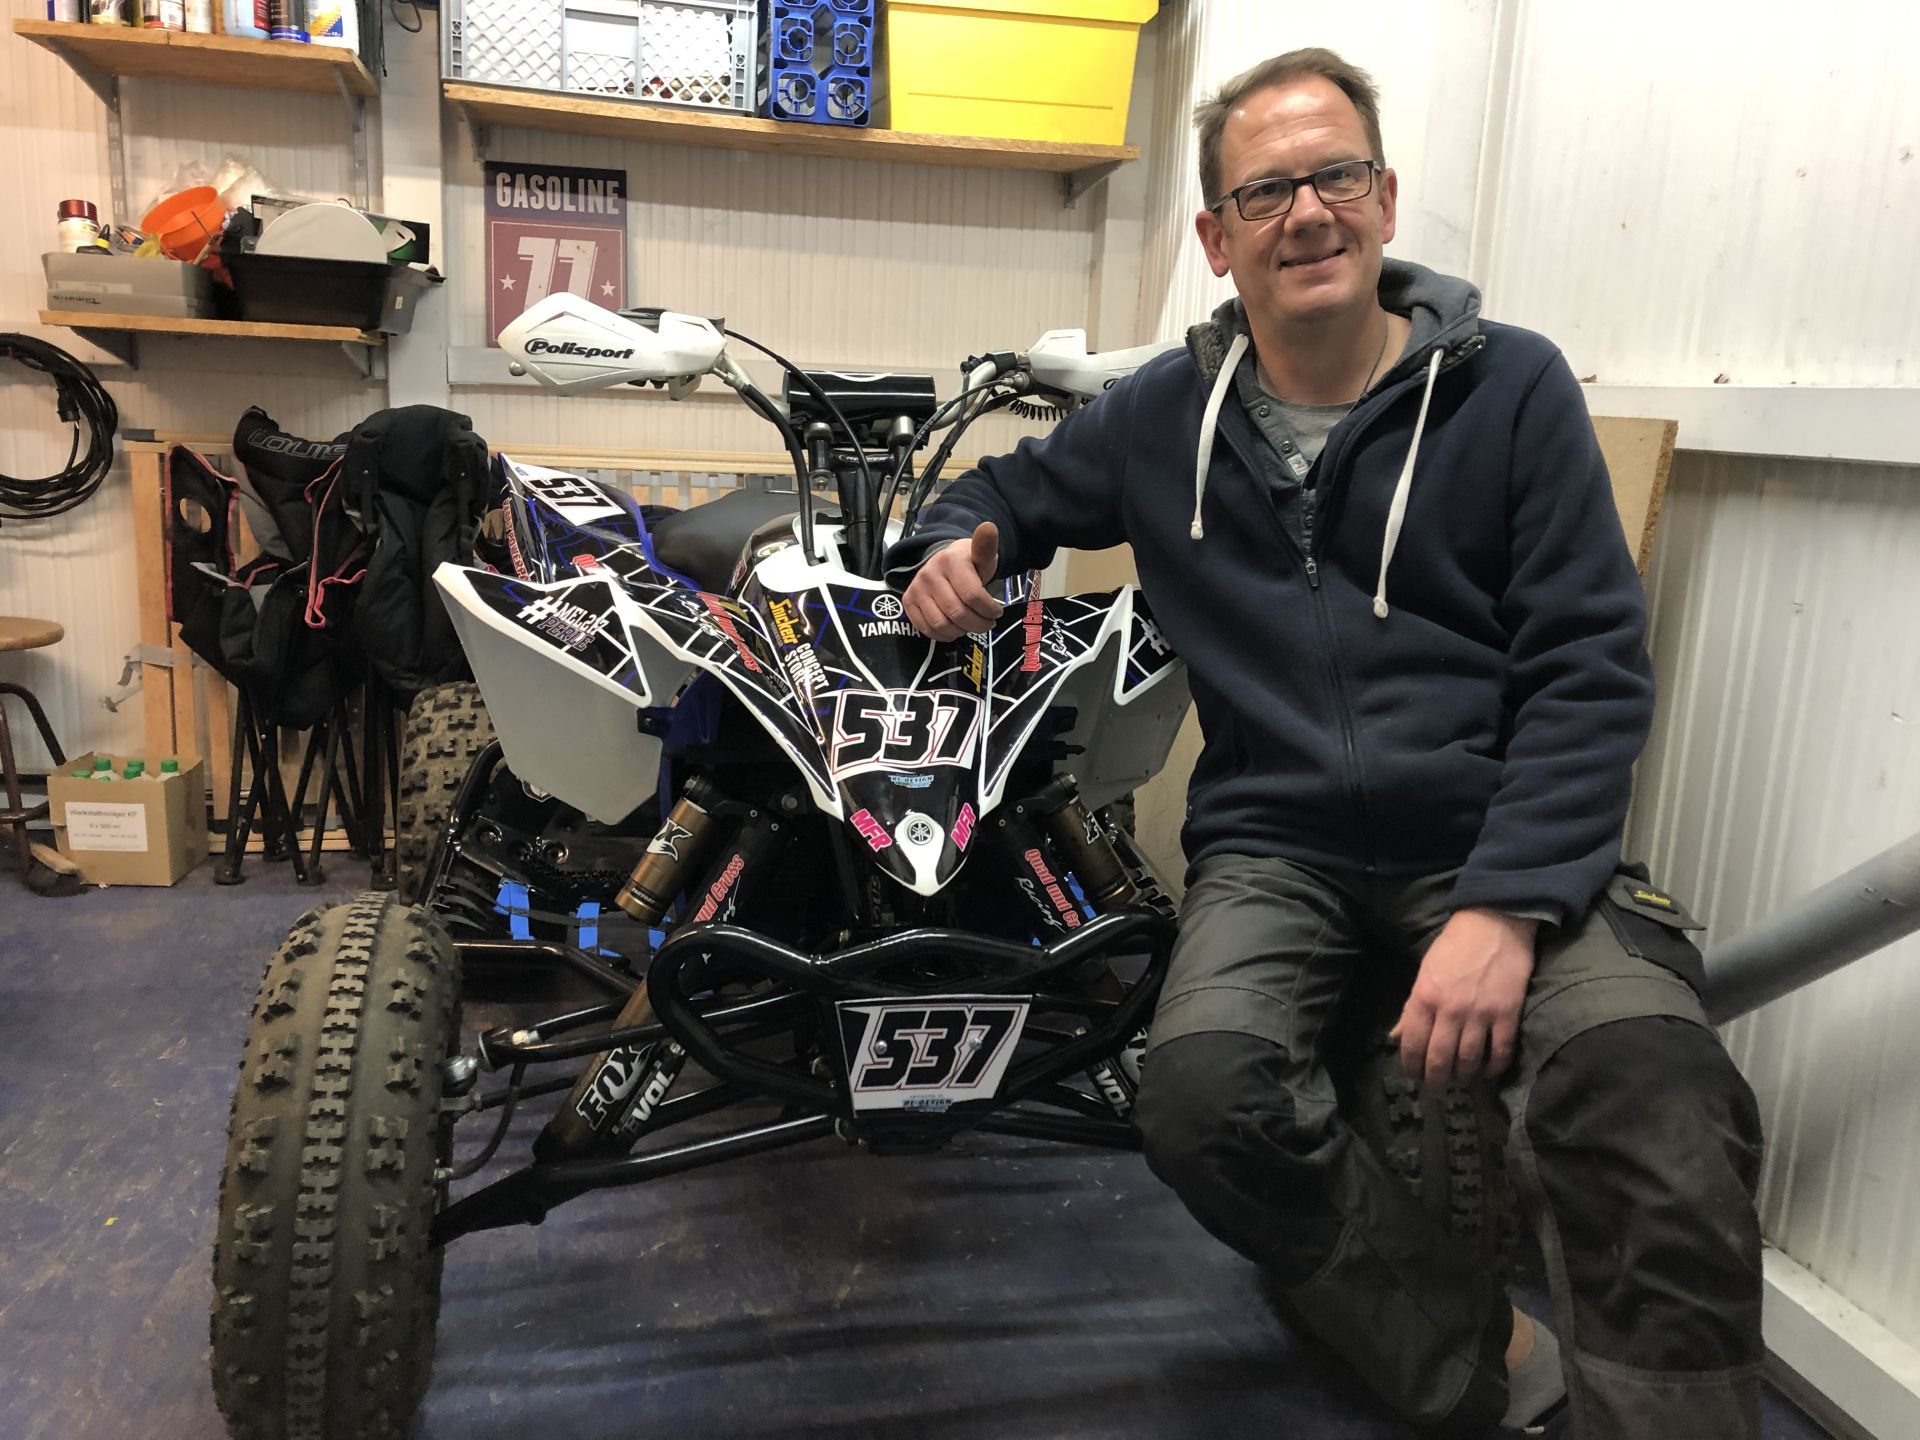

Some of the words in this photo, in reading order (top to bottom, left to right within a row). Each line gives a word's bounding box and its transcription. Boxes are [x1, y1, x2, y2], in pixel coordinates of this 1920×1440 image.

[495, 171, 620, 215] GASOLINE
[524, 337, 636, 360] Polisport
[524, 477, 614, 507] 537
[537, 615, 596, 652] PERLE
[858, 620, 921, 638] YAMAHA
[797, 642, 830, 690] CONCEPT
[834, 690, 979, 769] 537
[850, 808, 893, 852] MFR
[950, 802, 977, 852] MFR
[710, 854, 745, 902] Cross
[1025, 848, 1056, 885] Quad
[1046, 883, 1073, 912] und
[854, 1006, 1020, 1091] 537
[576, 1043, 657, 1131] FOX
